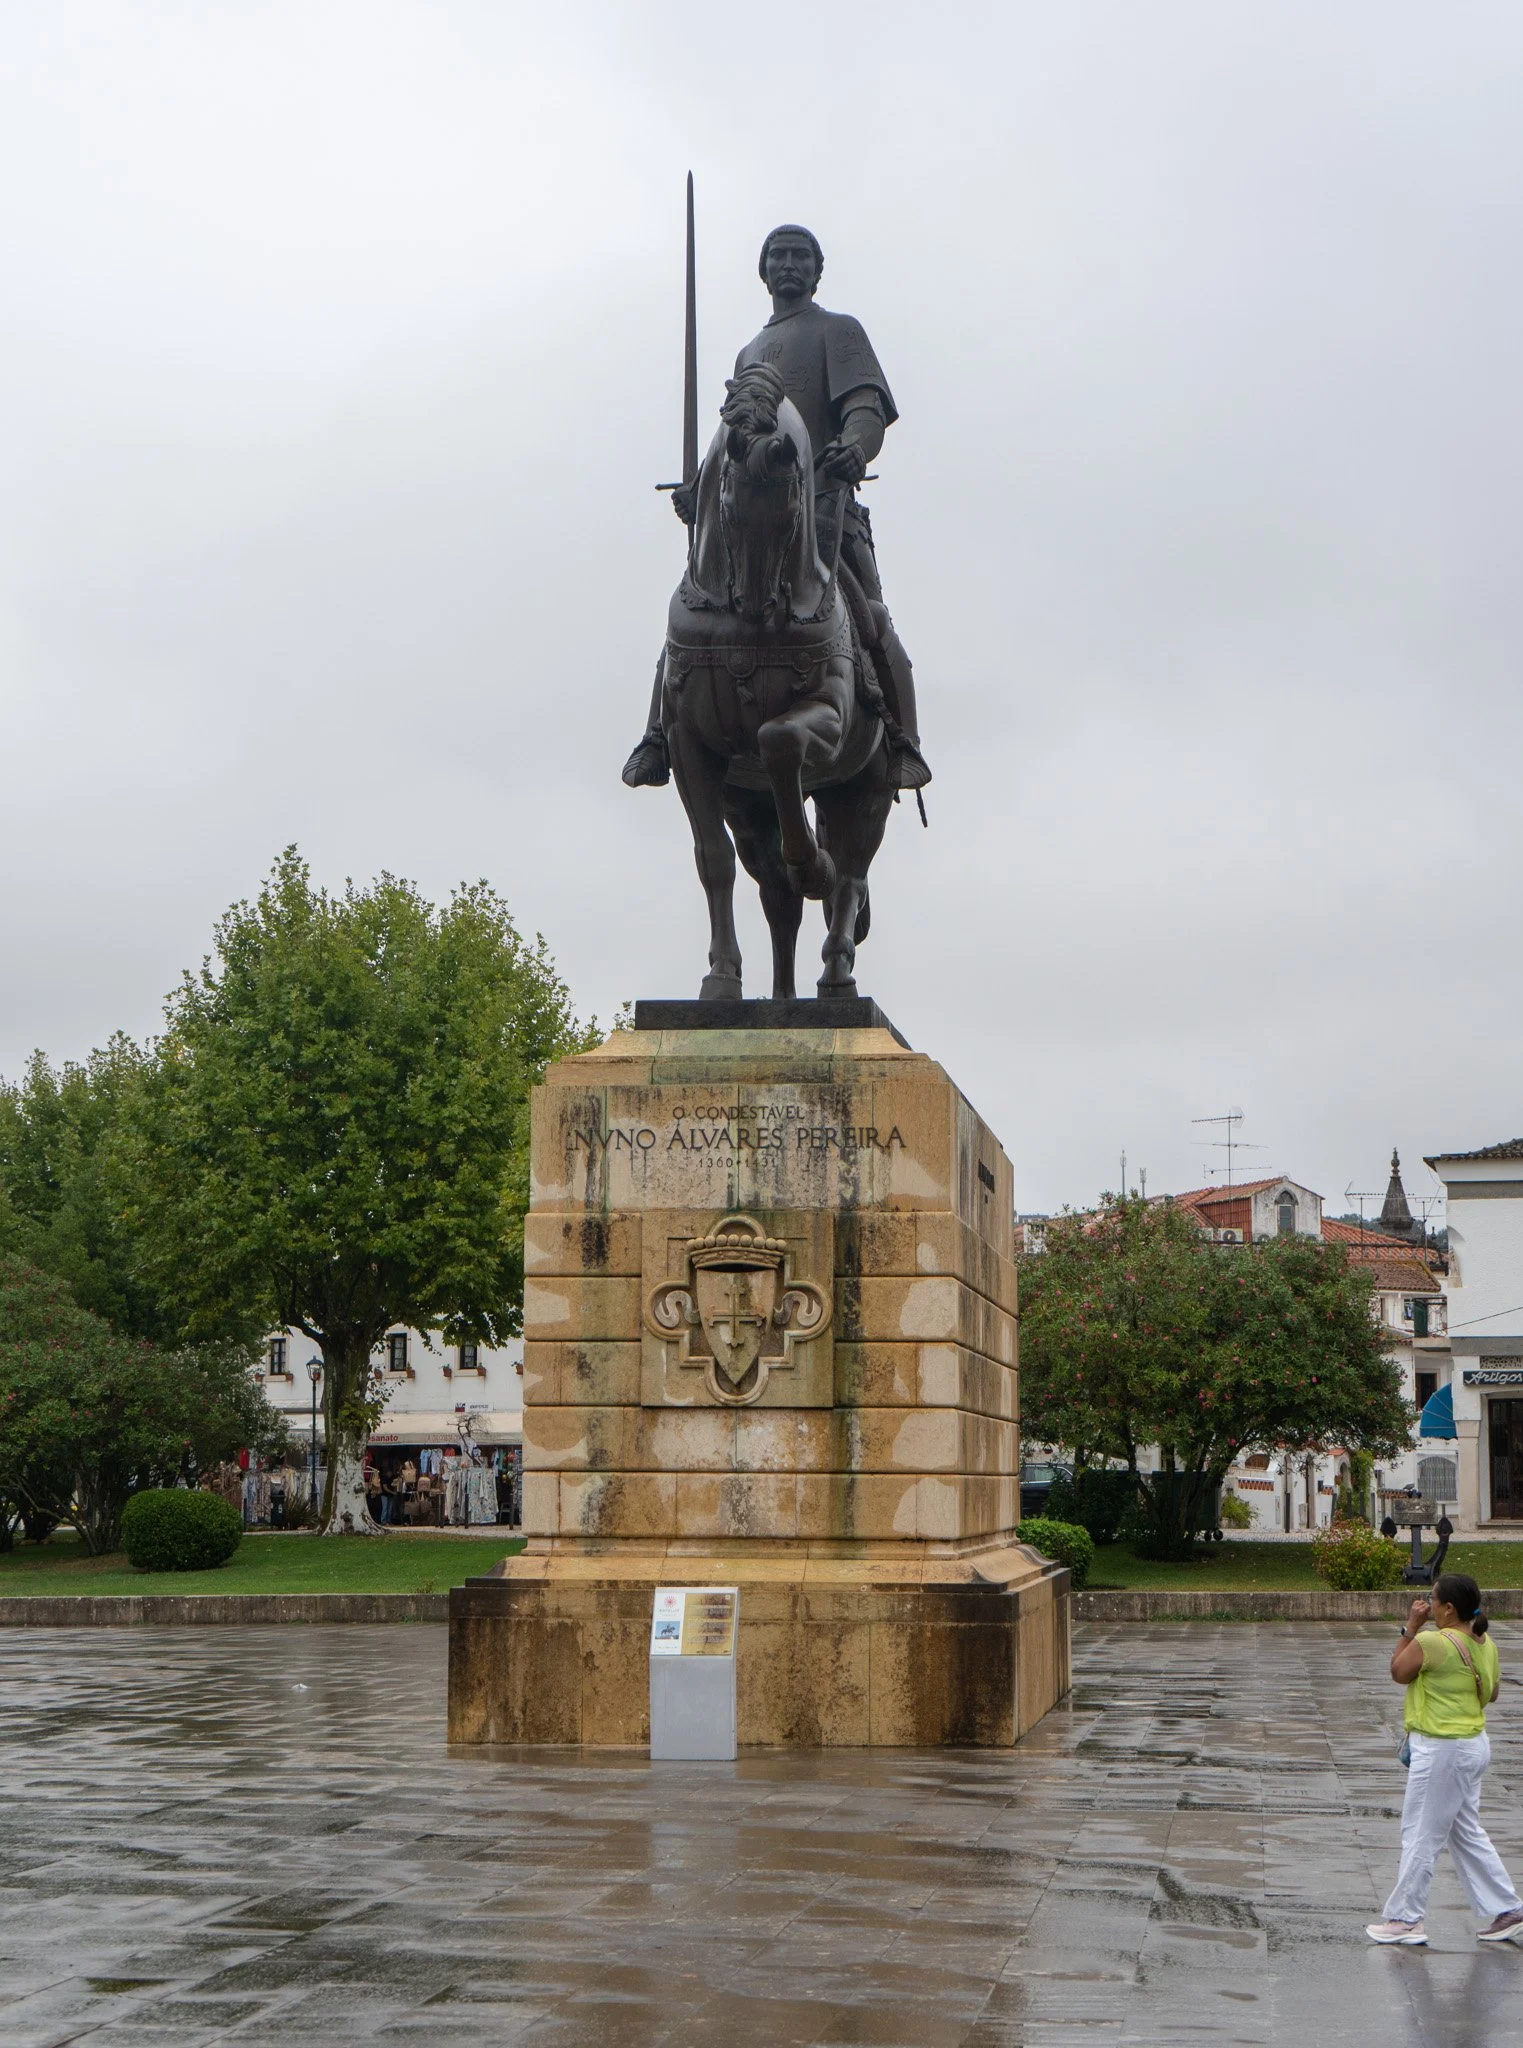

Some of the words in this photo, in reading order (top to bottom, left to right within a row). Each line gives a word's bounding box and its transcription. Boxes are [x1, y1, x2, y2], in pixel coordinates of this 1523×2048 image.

[672, 1106, 685, 1120] O
[575, 1128, 656, 1150] NVNO
[797, 1125, 907, 1150] PEREIRA
[1465, 1371, 1523, 1384] Artigos
